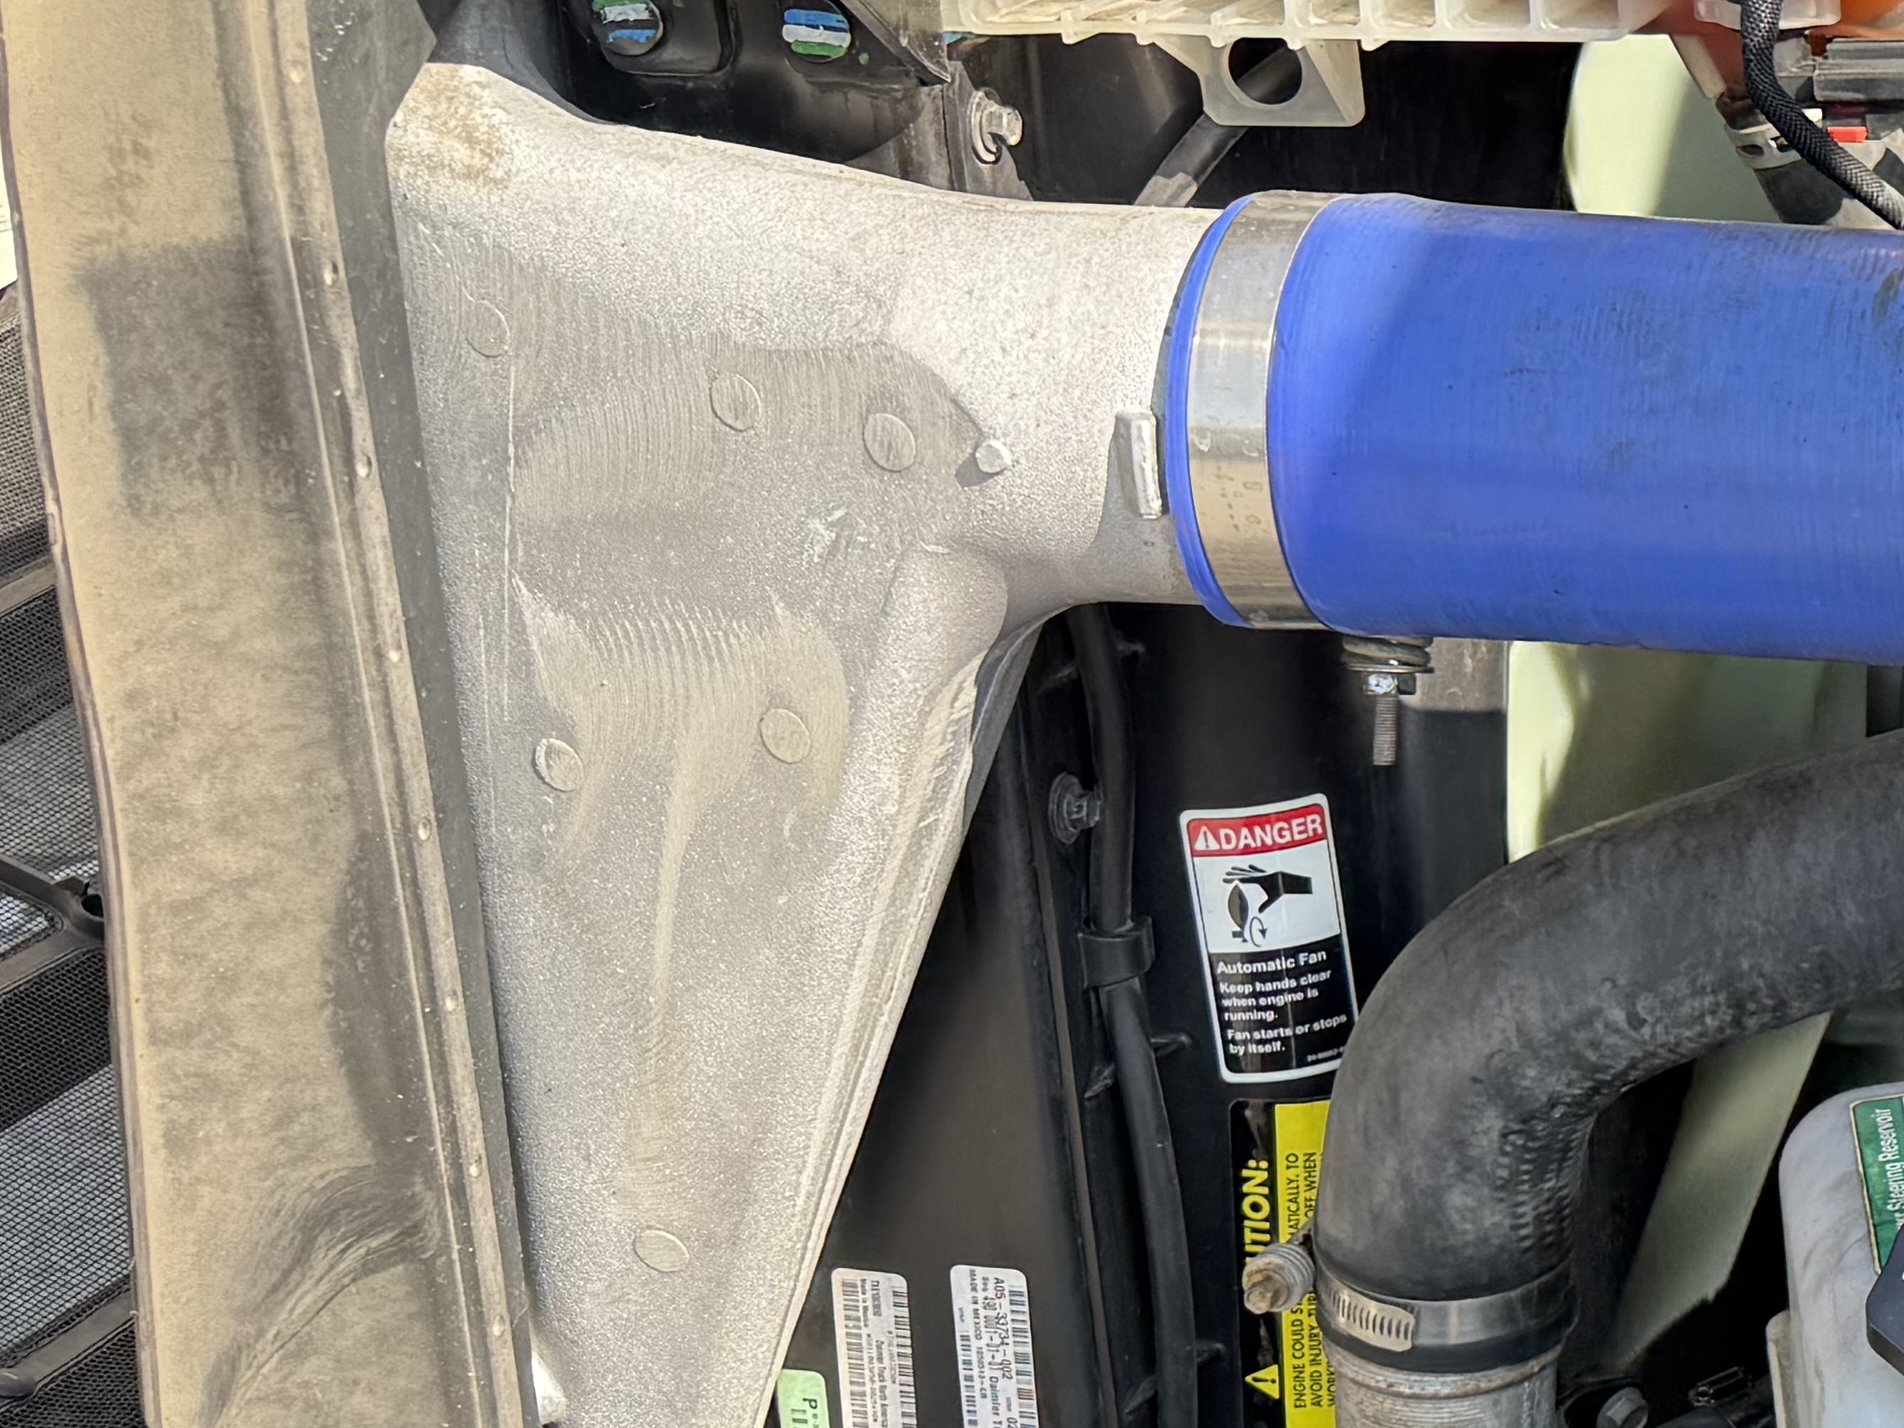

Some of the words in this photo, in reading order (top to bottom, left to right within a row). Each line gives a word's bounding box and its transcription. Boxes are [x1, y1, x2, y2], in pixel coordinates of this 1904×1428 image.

[1220, 813, 1323, 851] DANGER
[1217, 956, 1295, 974] Automatic
[1300, 950, 1327, 966] Fan
[1219, 981, 1253, 995] Keep
[1255, 978, 1297, 992] hands
[1300, 970, 1332, 985] clear
[1222, 996, 1256, 1008] when
[1259, 992, 1304, 1007] engine
[1307, 987, 1319, 999] is
[1224, 1008, 1278, 1022] running.
[1227, 1029, 1250, 1040] Fan
[1254, 1026, 1292, 1039] starts
[1296, 1023, 1310, 1034] or
[1313, 1014, 1347, 1032] stops
[1229, 1043, 1244, 1056] by
[1248, 1041, 1286, 1054] itself.
[1875, 1108, 1899, 1162] Reservoir
[1286, 1152, 1299, 1171] TO
[1303, 1152, 1317, 1193] WHEN
[1291, 1318, 1305, 1359] COULD
[989, 1375, 1001, 1416] Daimler
[1292, 1363, 1307, 1408] ENGINE
[1309, 1374, 1323, 1408] AVOID
[802, 1397, 818, 1410] P
